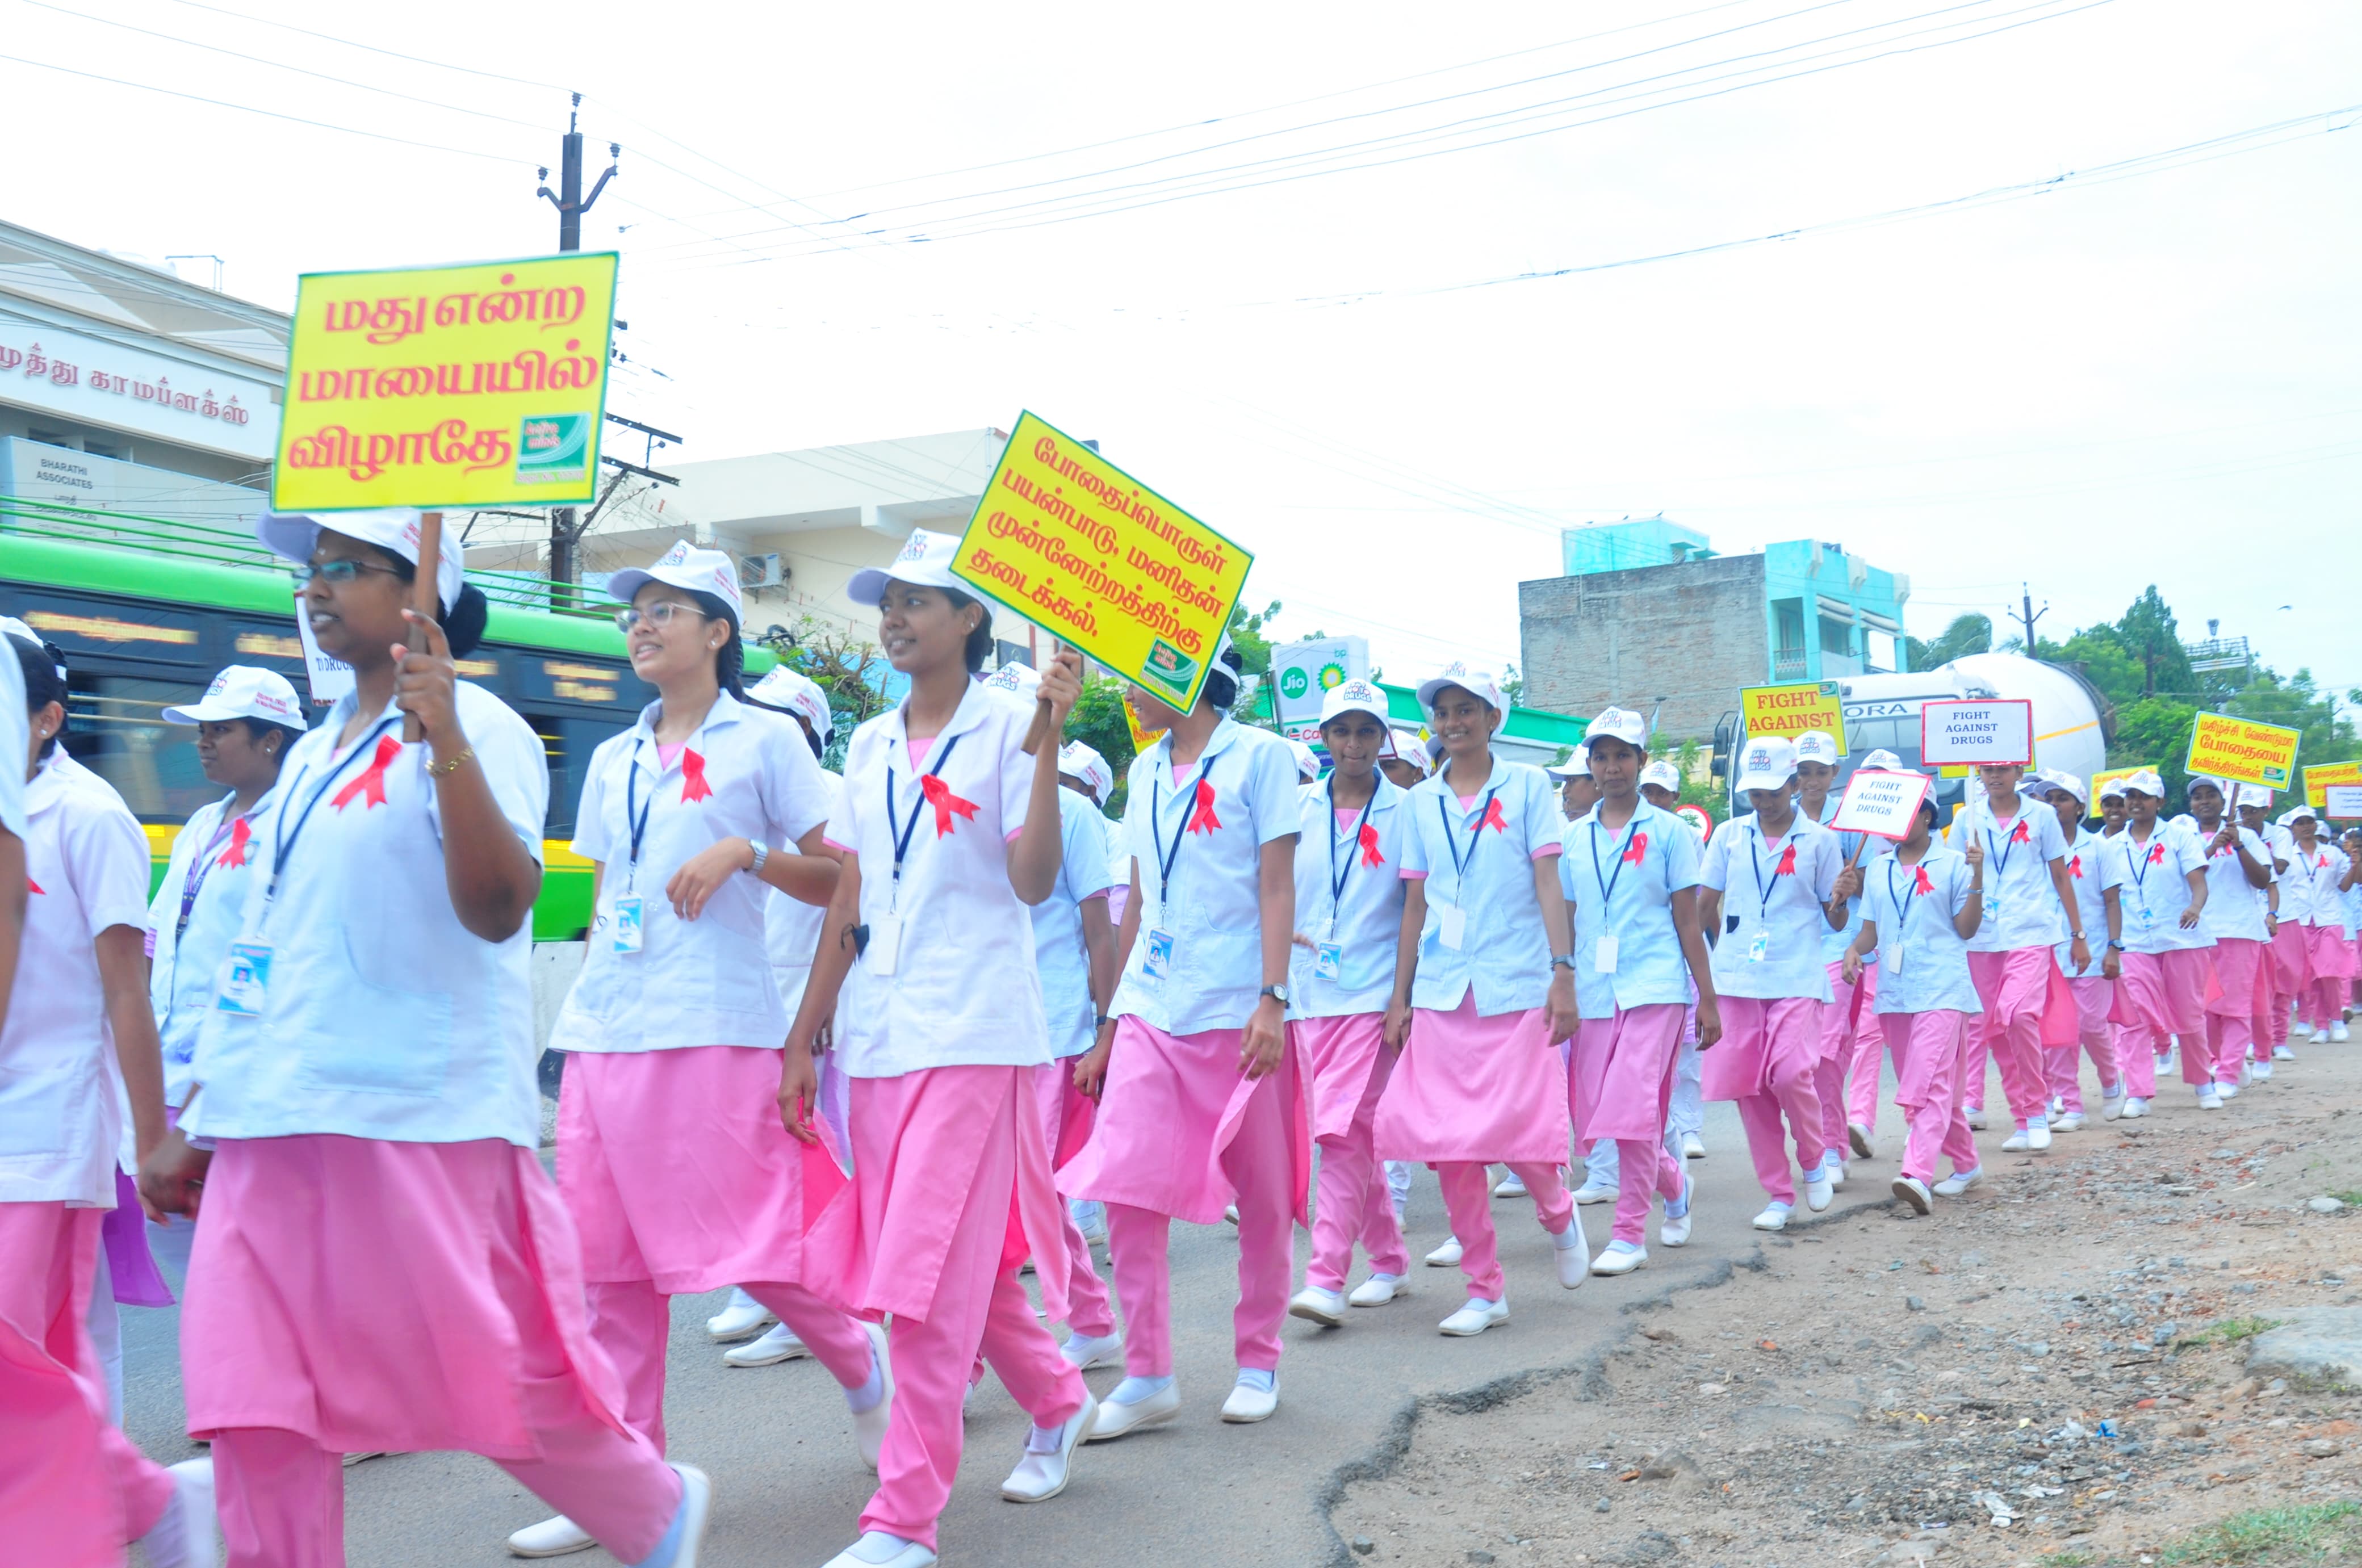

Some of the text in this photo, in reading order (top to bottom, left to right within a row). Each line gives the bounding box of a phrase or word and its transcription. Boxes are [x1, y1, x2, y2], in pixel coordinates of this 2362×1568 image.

[326, 273, 585, 344] மது என்ற
[300, 338, 598, 401] மாயையில்
[288, 419, 512, 481] விழாதே
[40, 459, 87, 476] BHARATHI
[36, 471, 93, 489] ASSOCIATES
[1034, 438, 1226, 575] போதைப்பொருள்
[987, 512, 1202, 655] முன்னேற்றத்திற்கு
[1126, 546, 1225, 618] மனிதன்
[1335, 648, 1347, 659] bp
[1283, 673, 1306, 690] Jio
[1343, 692, 1372, 703] DRUGS
[1756, 691, 1819, 710] FIGHT
[1748, 712, 1836, 732] AGAINST
[1953, 711, 1991, 720] FIGHT
[1945, 723, 1999, 732] AGAINST
[1951, 735, 1993, 744] DRUGS
[2200, 733, 2287, 764] போதையை
[1870, 781, 1902, 791] FIGHT
[1857, 792, 1903, 804] AGAINST
[1856, 804, 1892, 815] DRUGS
